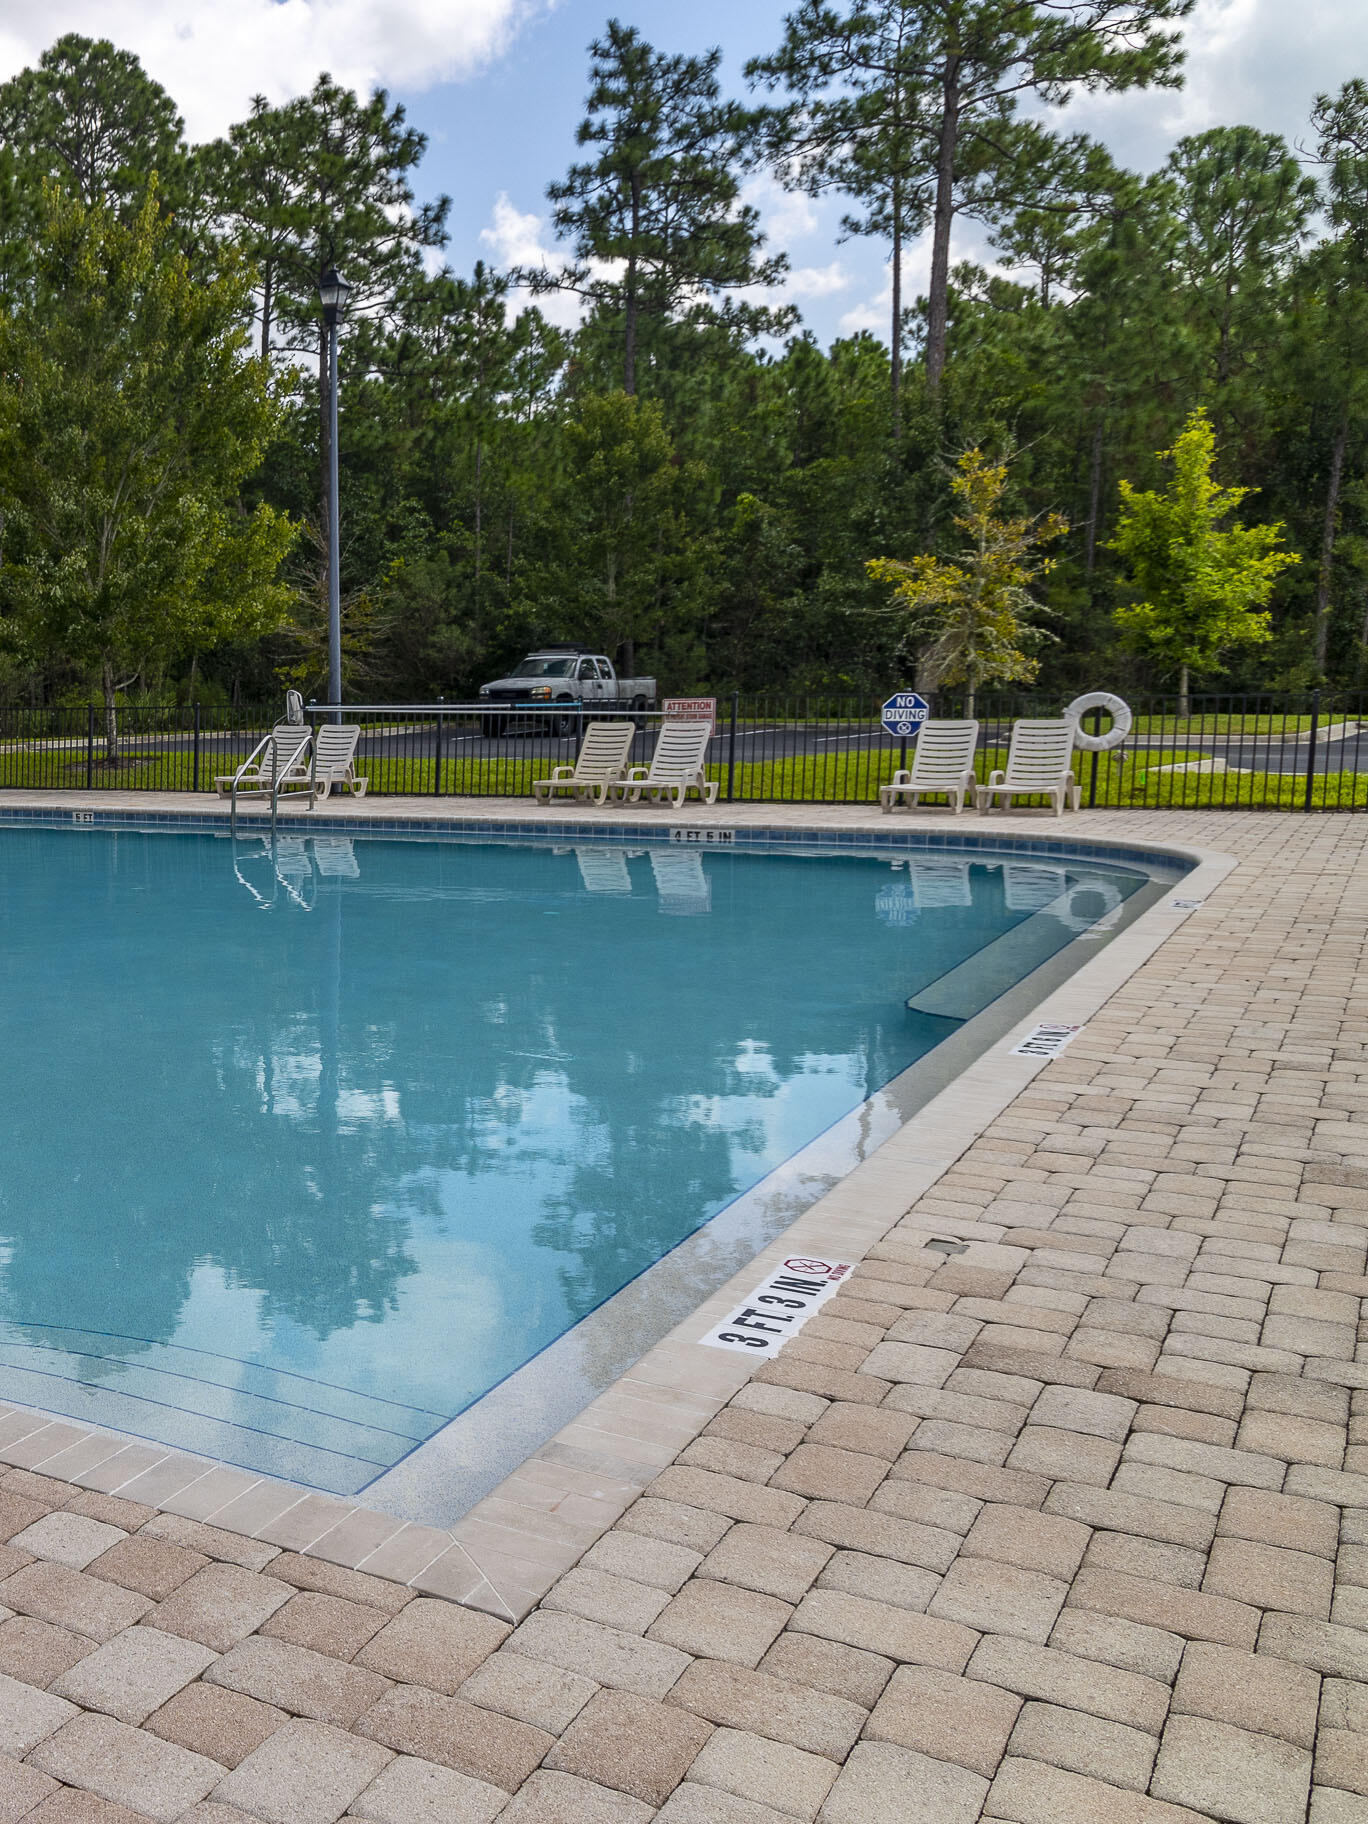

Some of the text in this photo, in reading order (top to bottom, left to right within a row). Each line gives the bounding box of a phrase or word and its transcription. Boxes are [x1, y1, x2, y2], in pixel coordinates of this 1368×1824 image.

[667, 701, 712, 711] ATTENTION
[896, 696, 915, 707] NO
[885, 709, 925, 720] DIVING
[718, 1275, 829, 1348] 3 FT. 3 IN.
